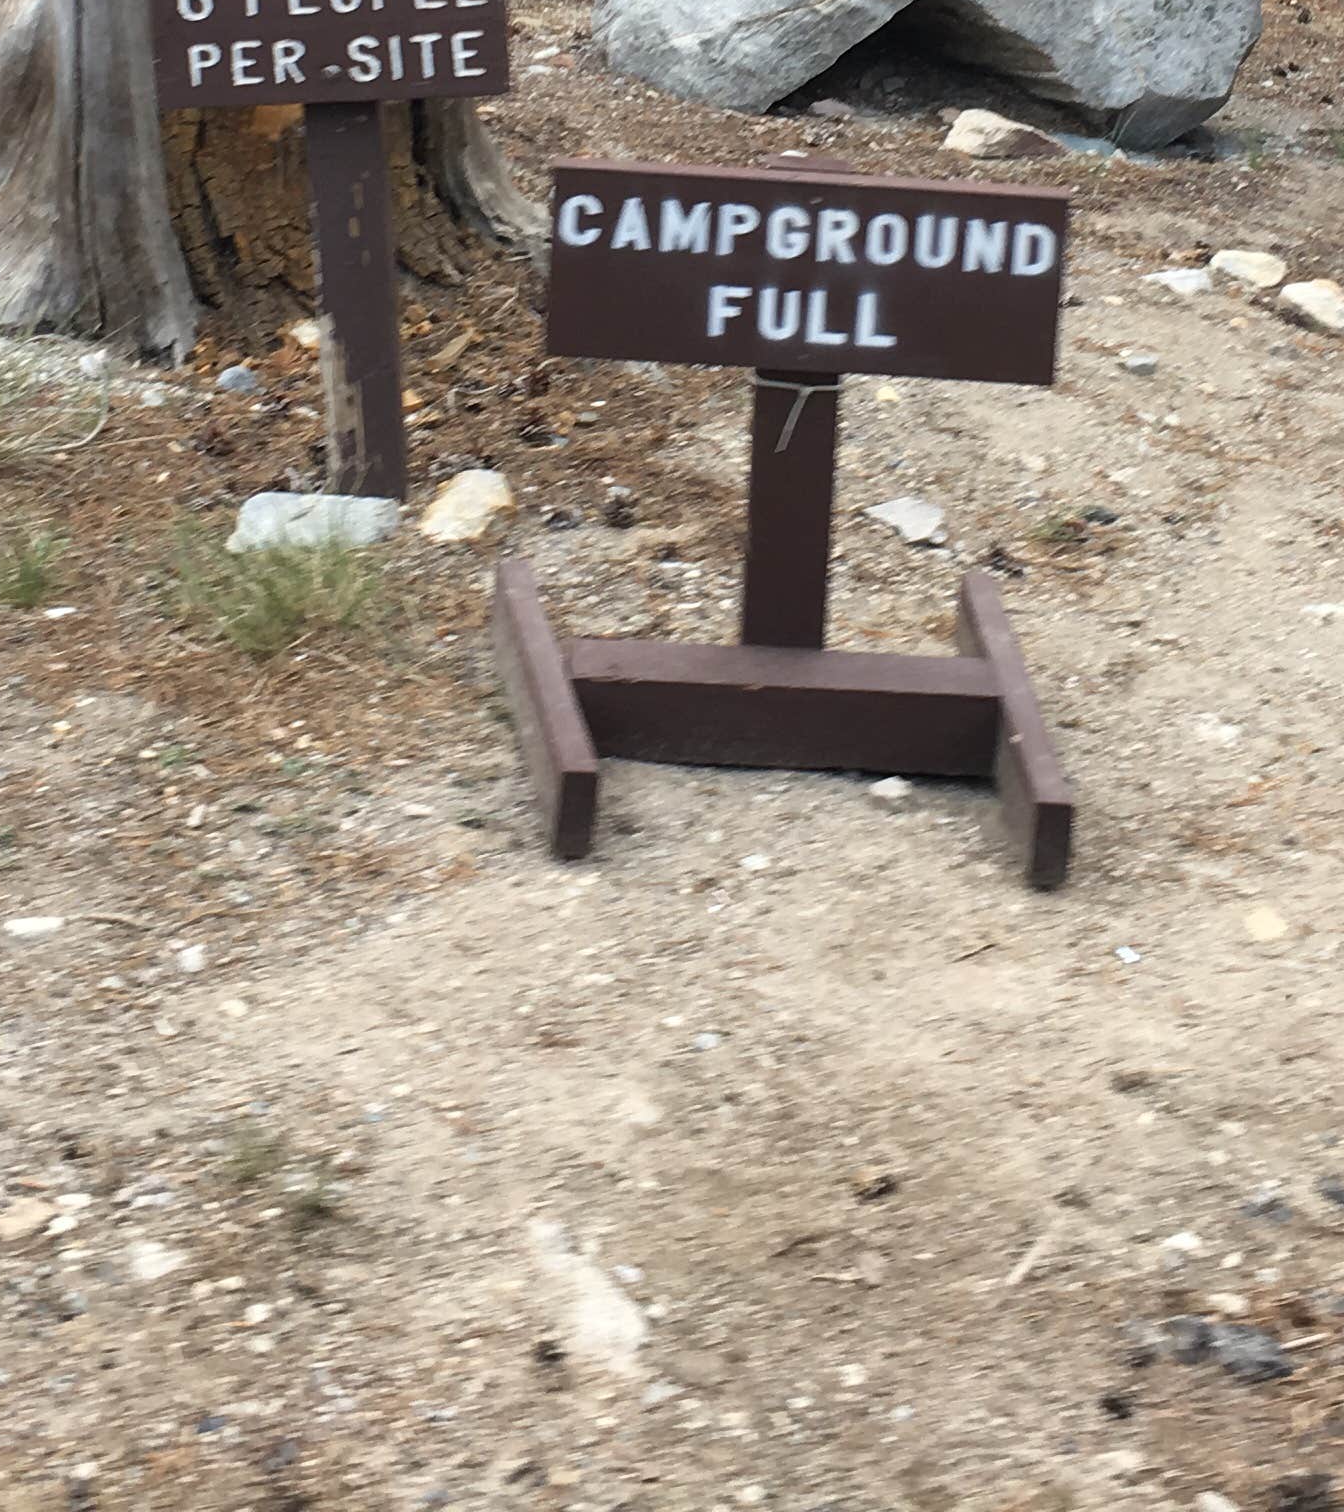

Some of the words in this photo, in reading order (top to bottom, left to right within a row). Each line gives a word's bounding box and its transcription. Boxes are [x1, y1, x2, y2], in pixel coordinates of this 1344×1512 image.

[188, 40, 305, 86] PER
[348, 32, 485, 81] SITE
[558, 193, 1057, 276] CAMPGROUND
[709, 286, 896, 347] FULL
